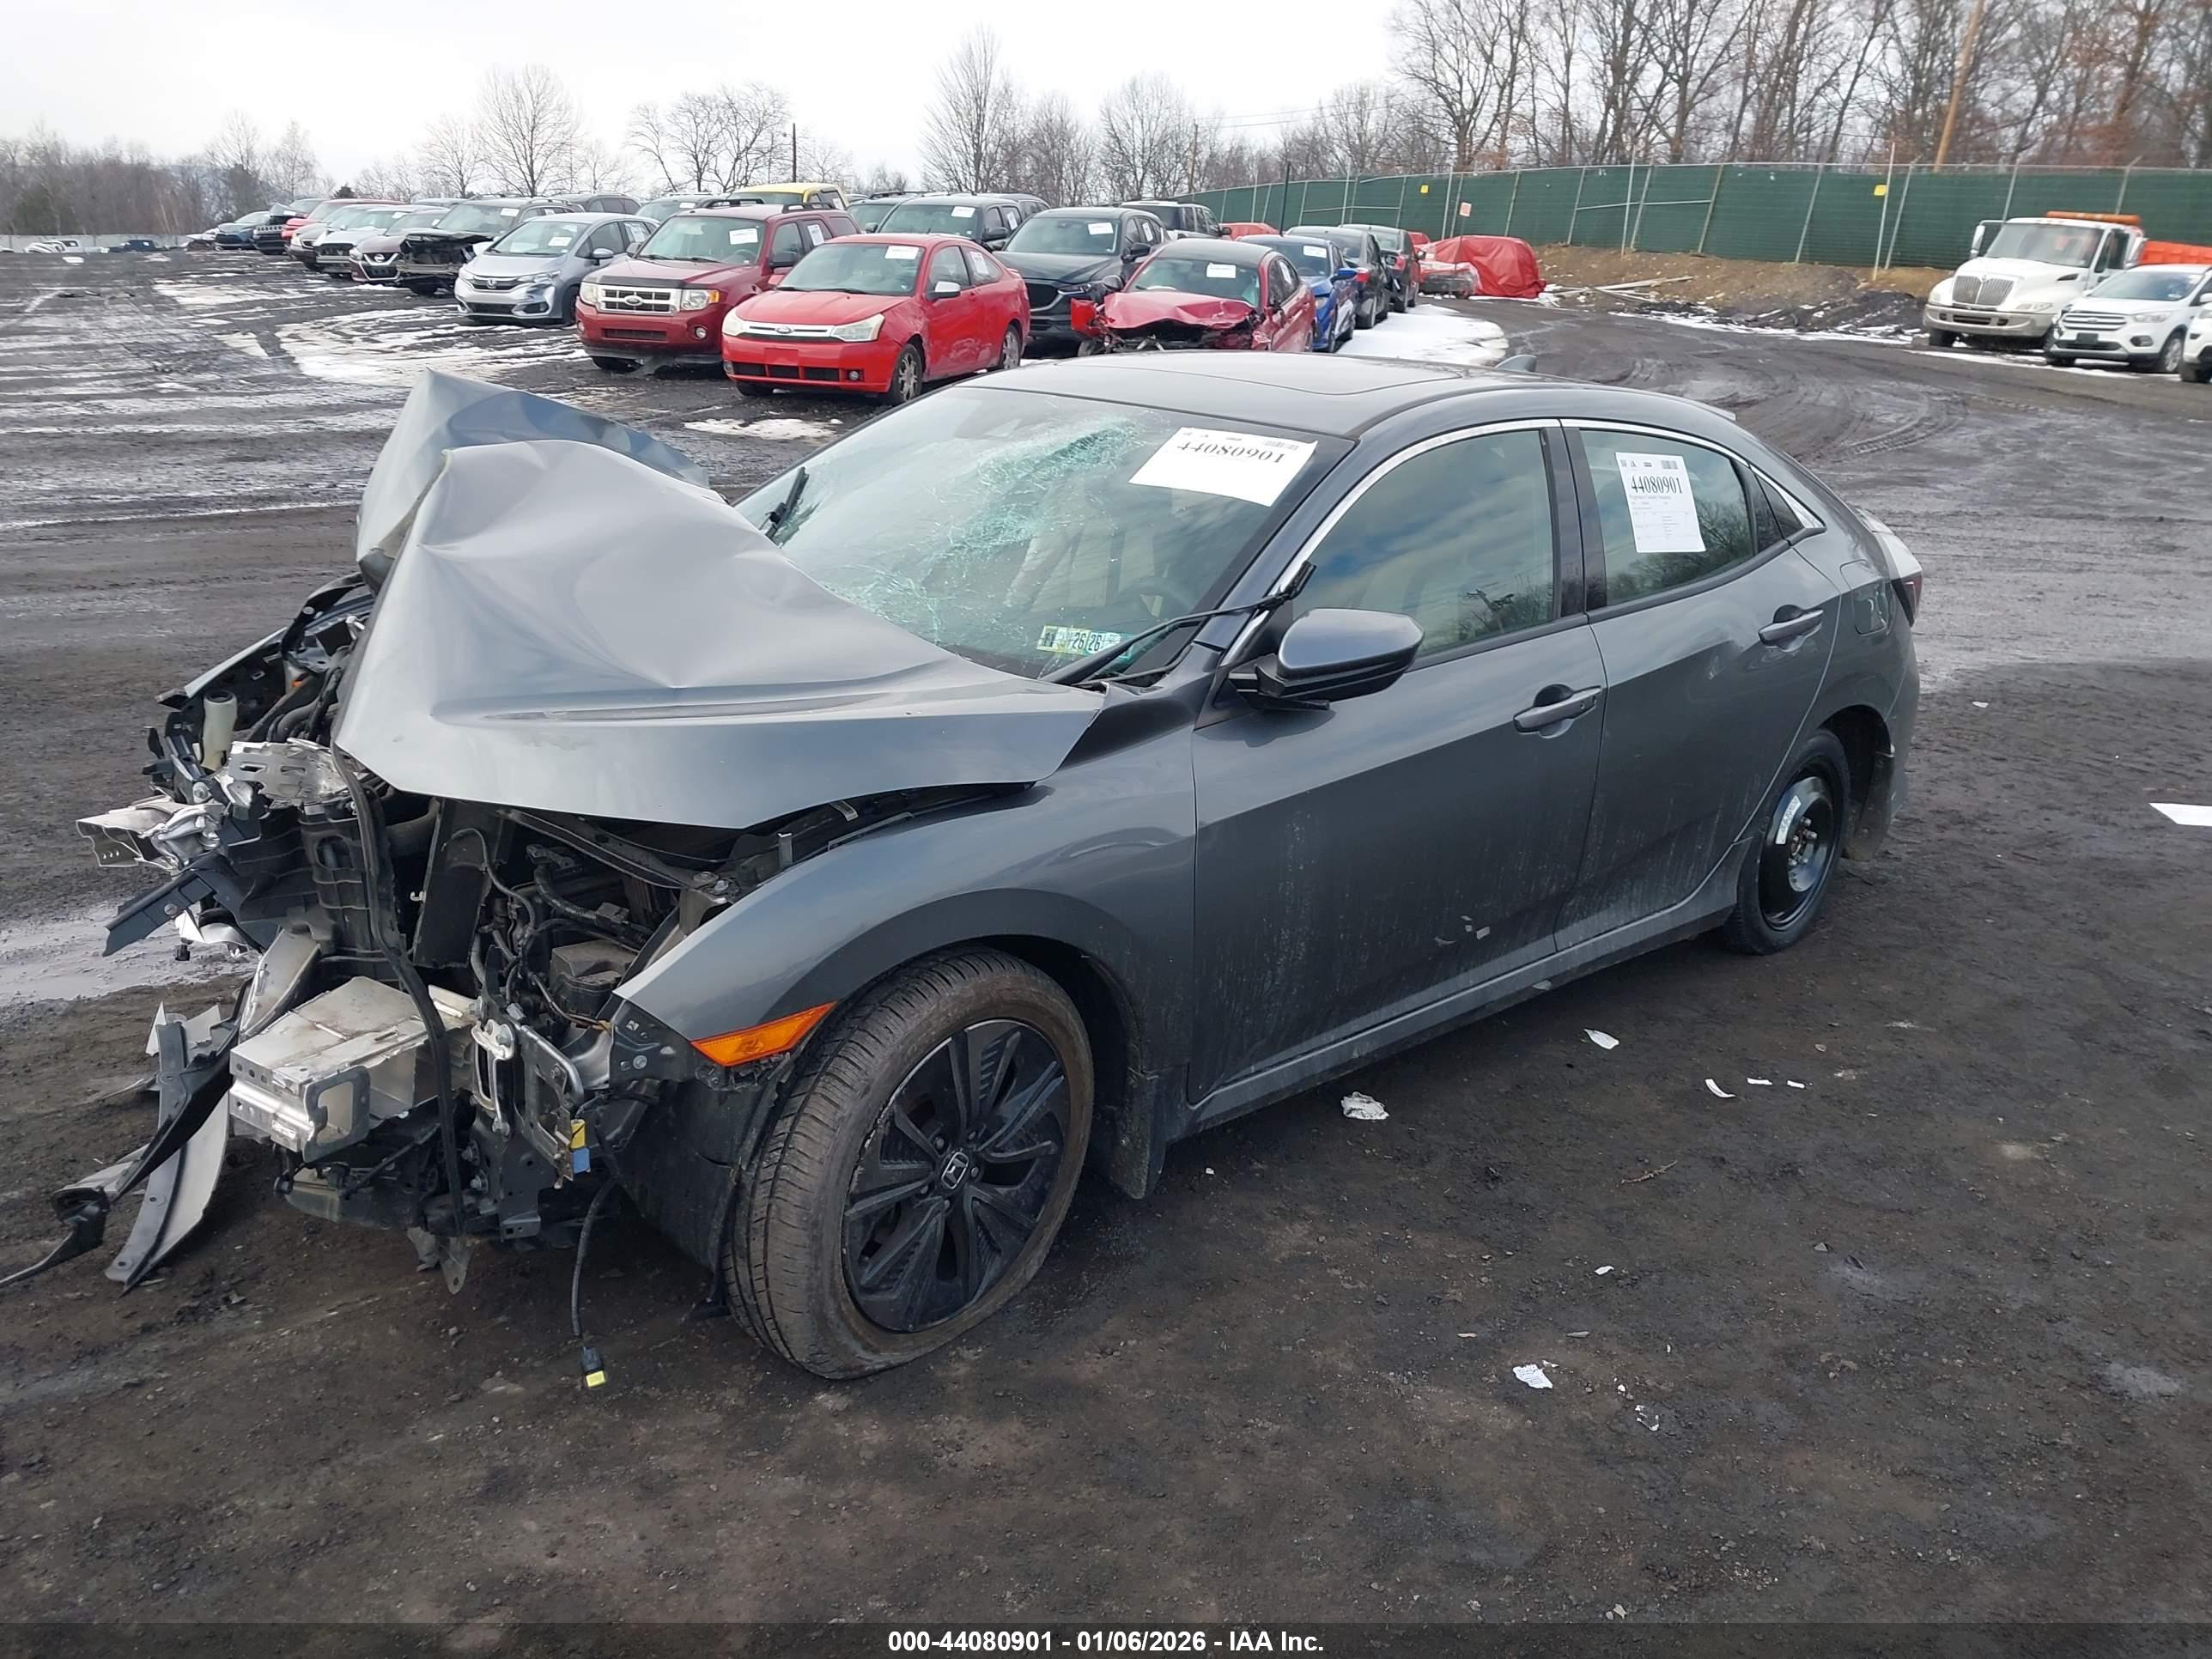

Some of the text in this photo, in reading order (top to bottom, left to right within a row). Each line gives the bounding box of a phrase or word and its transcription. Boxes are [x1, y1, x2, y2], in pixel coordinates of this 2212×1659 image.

[1177, 441, 1285, 463] 44080901
[1632, 475, 1682, 494] 44080901
[1073, 632, 1086, 650] 26
